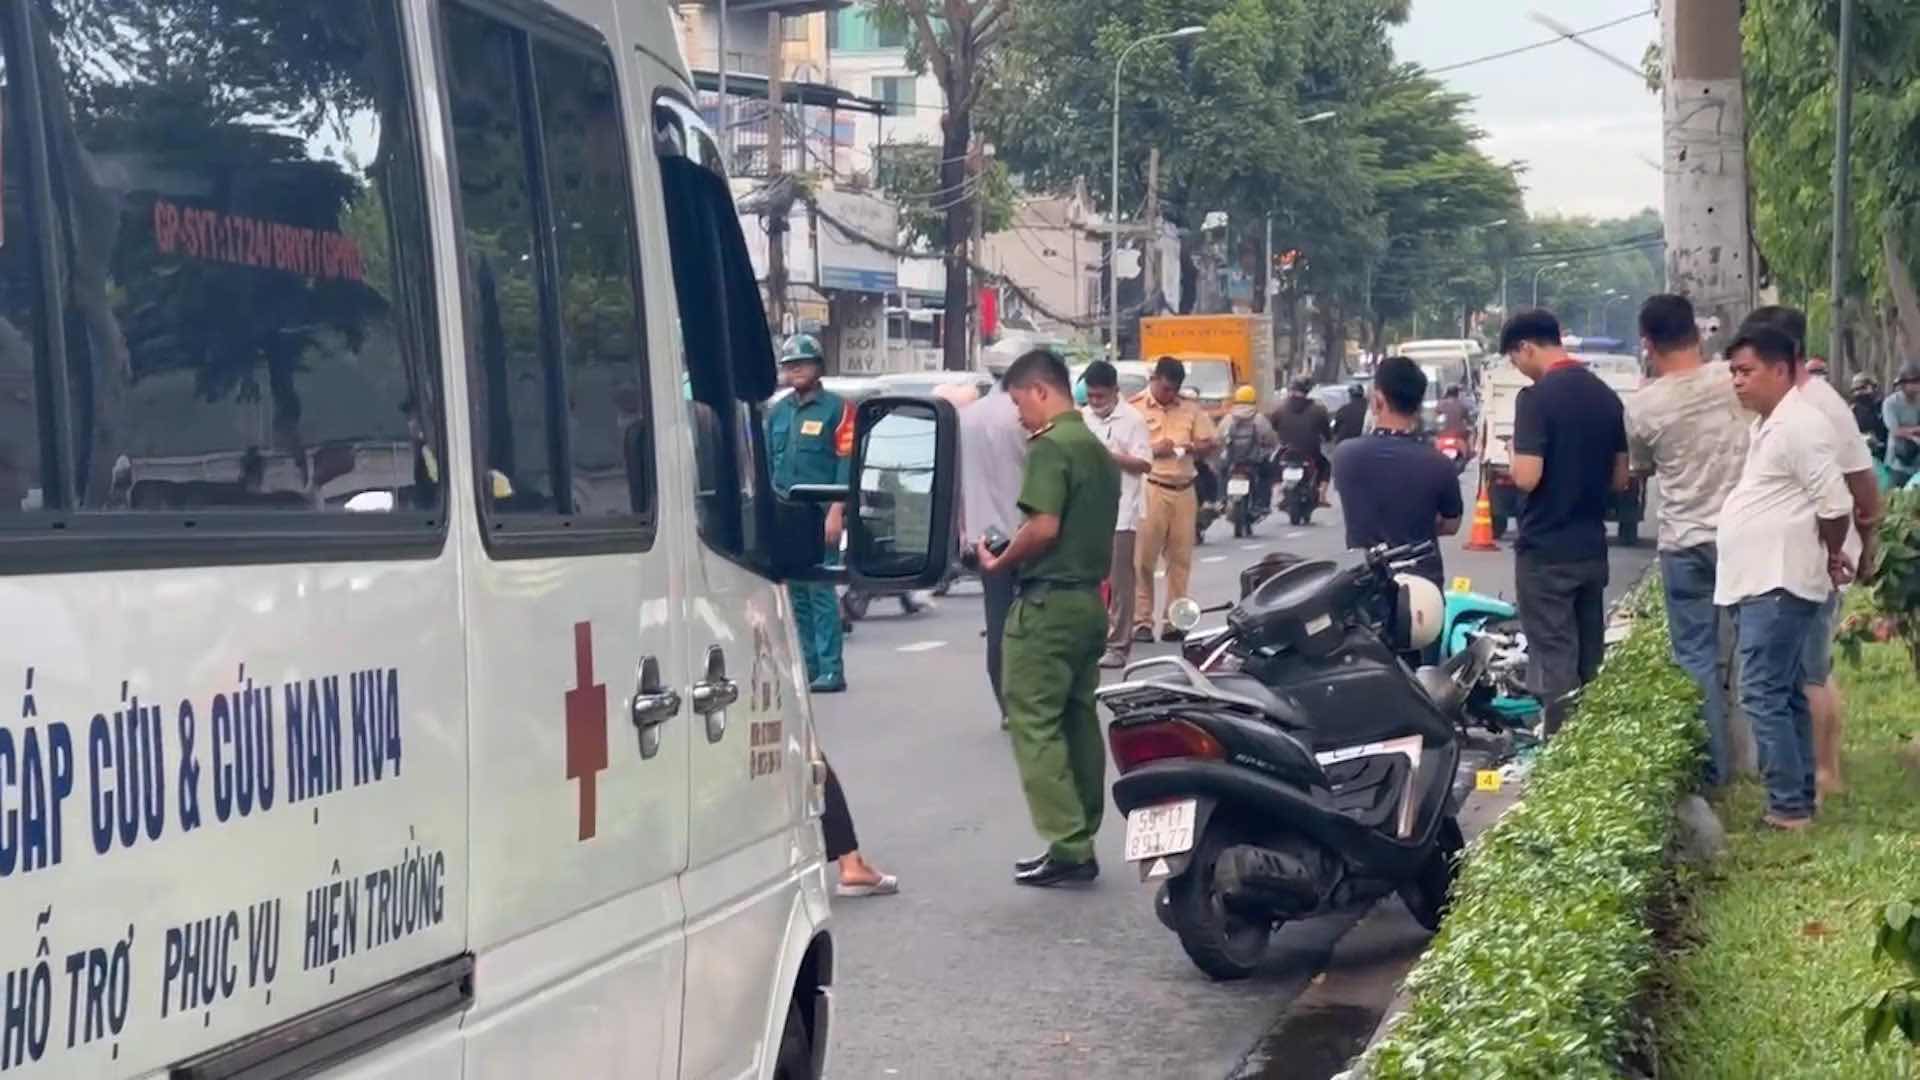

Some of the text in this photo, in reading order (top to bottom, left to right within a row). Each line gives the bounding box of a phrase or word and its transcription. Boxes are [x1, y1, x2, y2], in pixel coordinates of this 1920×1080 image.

[89, 680, 165, 855] CỨU
[179, 699, 201, 832] &
[211, 663, 275, 823] CỨU
[285, 675, 342, 825] NẠN
[2, 825, 445, 1071] HỖ TRỢ PHỤC VỤ HIỆN TRƯỜNG
